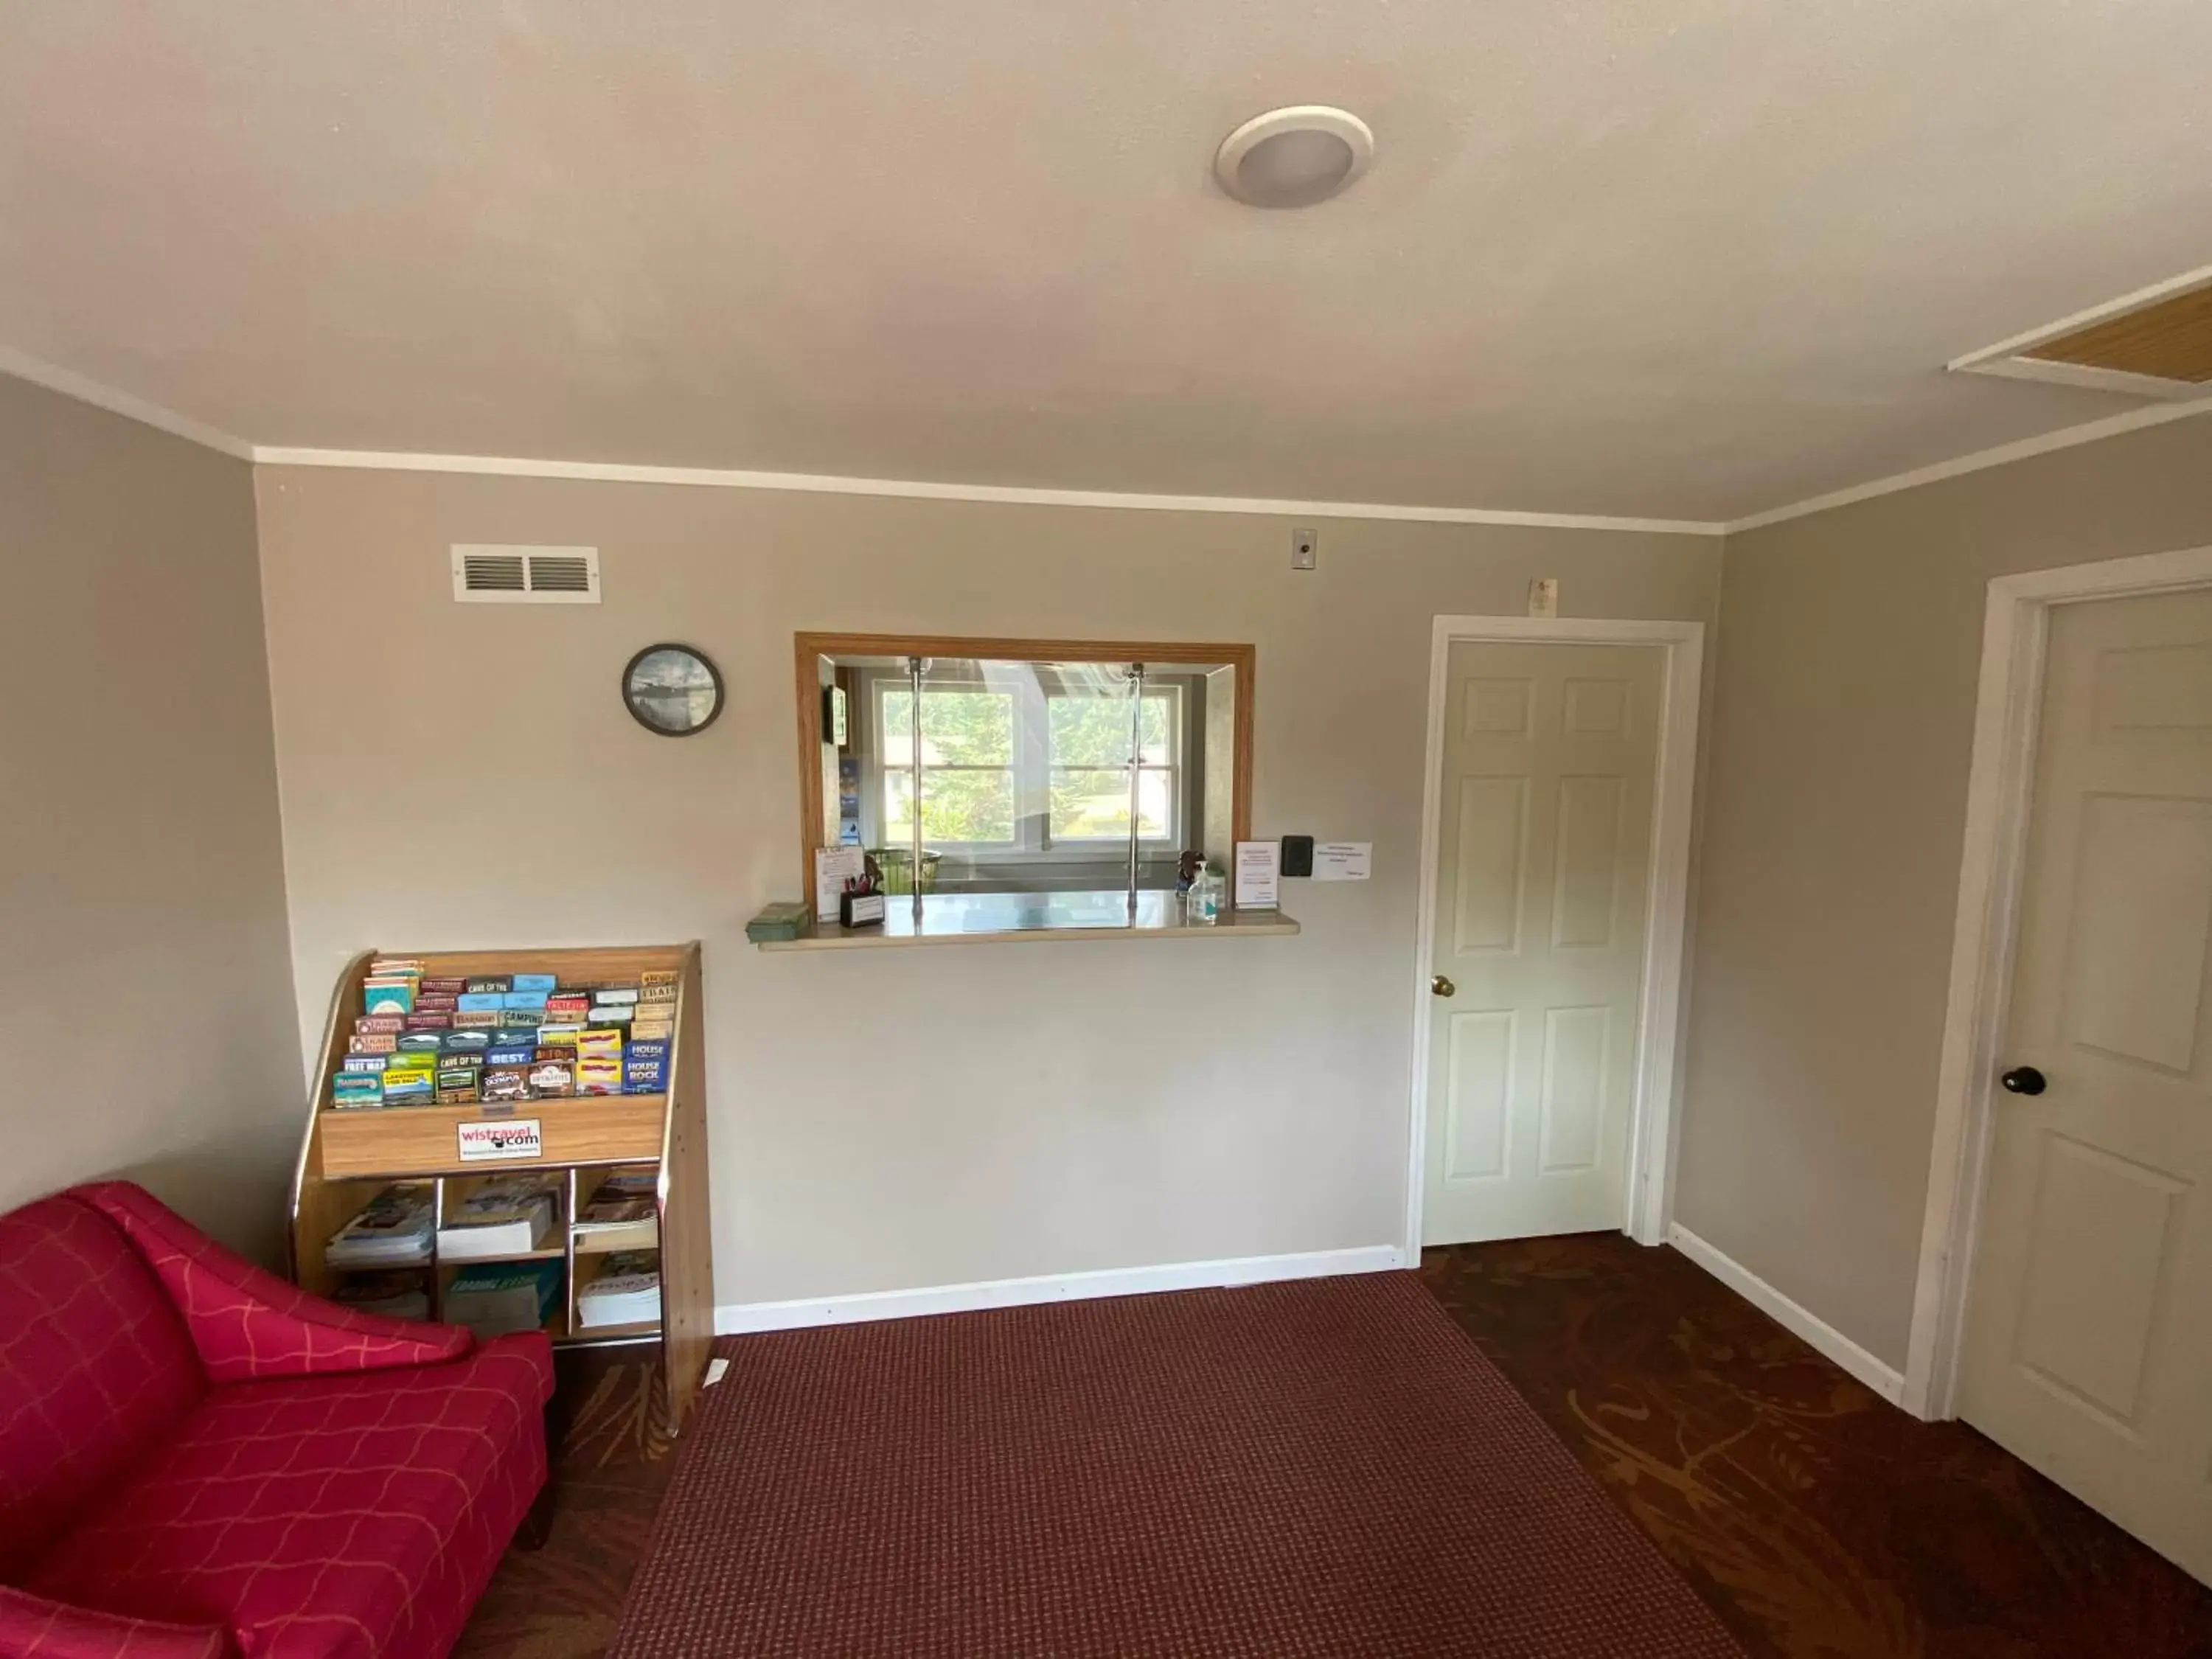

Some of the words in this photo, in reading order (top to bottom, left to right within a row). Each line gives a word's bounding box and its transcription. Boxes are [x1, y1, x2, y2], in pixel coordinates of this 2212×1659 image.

[632, 1045, 664, 1054] HOUSE
[491, 1053, 526, 1064] BEST
[627, 1062, 661, 1071] HOUSE
[629, 1071, 660, 1080] ROCK
[462, 1127, 531, 1142] wistravel
